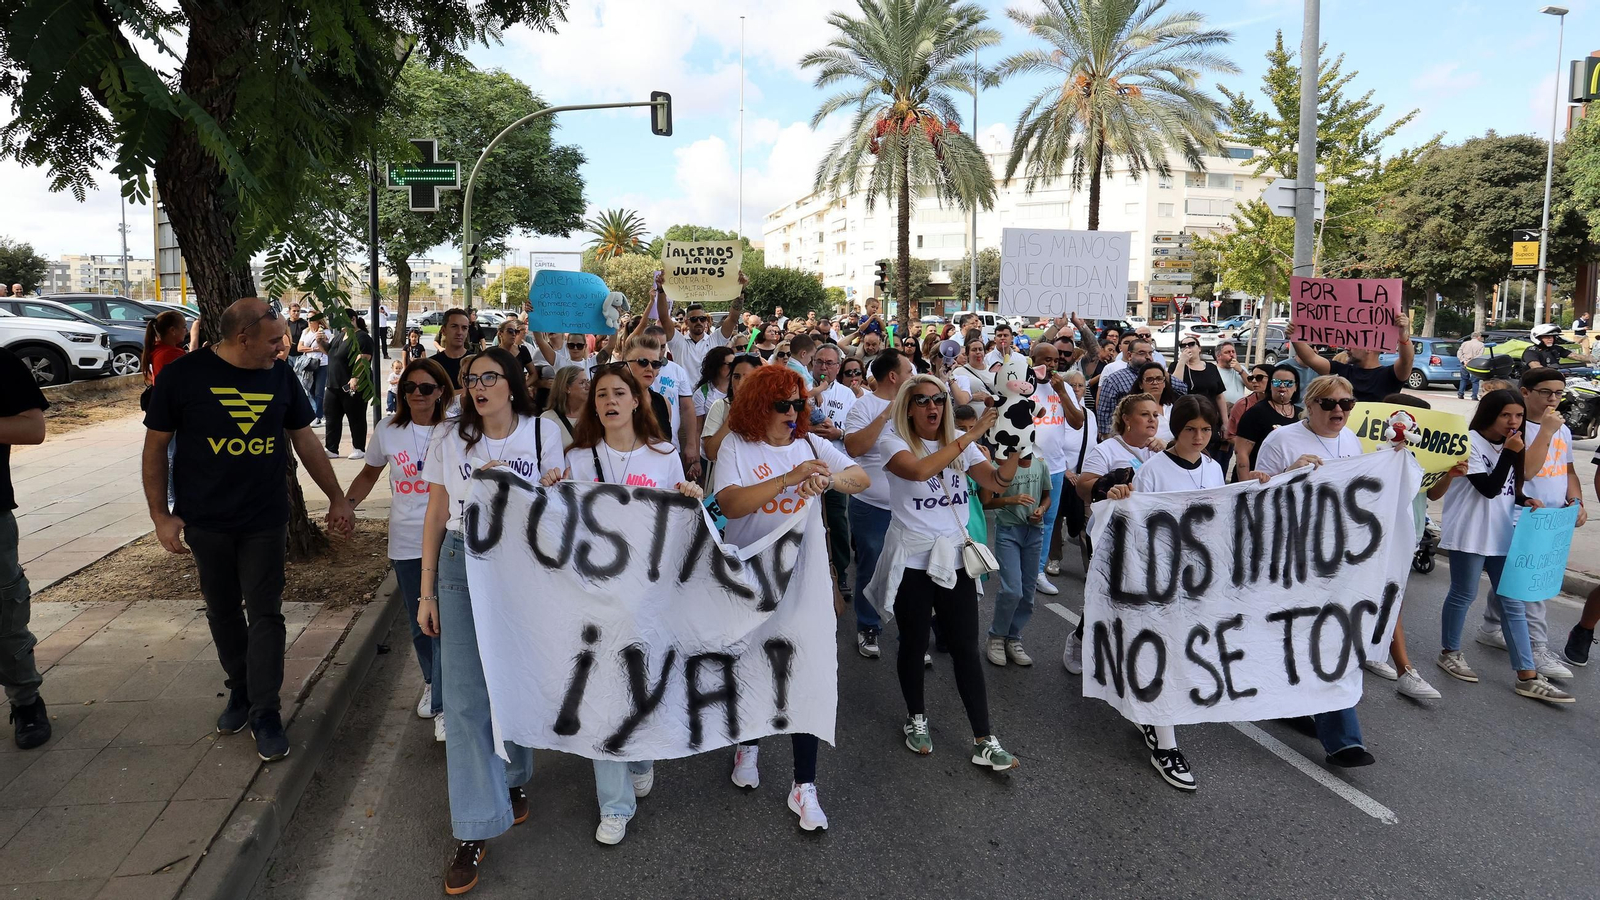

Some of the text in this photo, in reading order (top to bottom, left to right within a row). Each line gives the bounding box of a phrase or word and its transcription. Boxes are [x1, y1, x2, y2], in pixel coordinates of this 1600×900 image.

[1004, 230, 1121, 261] LAS MANOS
[705, 257, 728, 265] VOZ
[535, 273, 603, 287] Quien hace
[673, 267, 725, 278] JUNTOS
[1002, 262, 1118, 289] QUE CUIDAN
[668, 277, 699, 285] CONTRA
[540, 291, 562, 299] daño
[1301, 281, 1388, 304] POR LA
[1000, 288, 1126, 317] NO GOLPEAN
[561, 321, 591, 329] humano
[827, 400, 843, 410] NIÑOS
[1033, 416, 1064, 425] OCAN
[207, 437, 275, 456] VOGE
[393, 450, 410, 466] LOS
[403, 463, 418, 478] NO
[459, 463, 472, 481] LO
[752, 462, 773, 480] LOS
[927, 476, 941, 493] NO
[951, 474, 960, 489] SE
[755, 498, 806, 514] OCA
[1109, 502, 1215, 605] LOS
[1515, 554, 1535, 569] AL
[1092, 617, 1166, 702] NO
[1185, 614, 1258, 706] SE
[553, 623, 795, 753] ¡YA!
